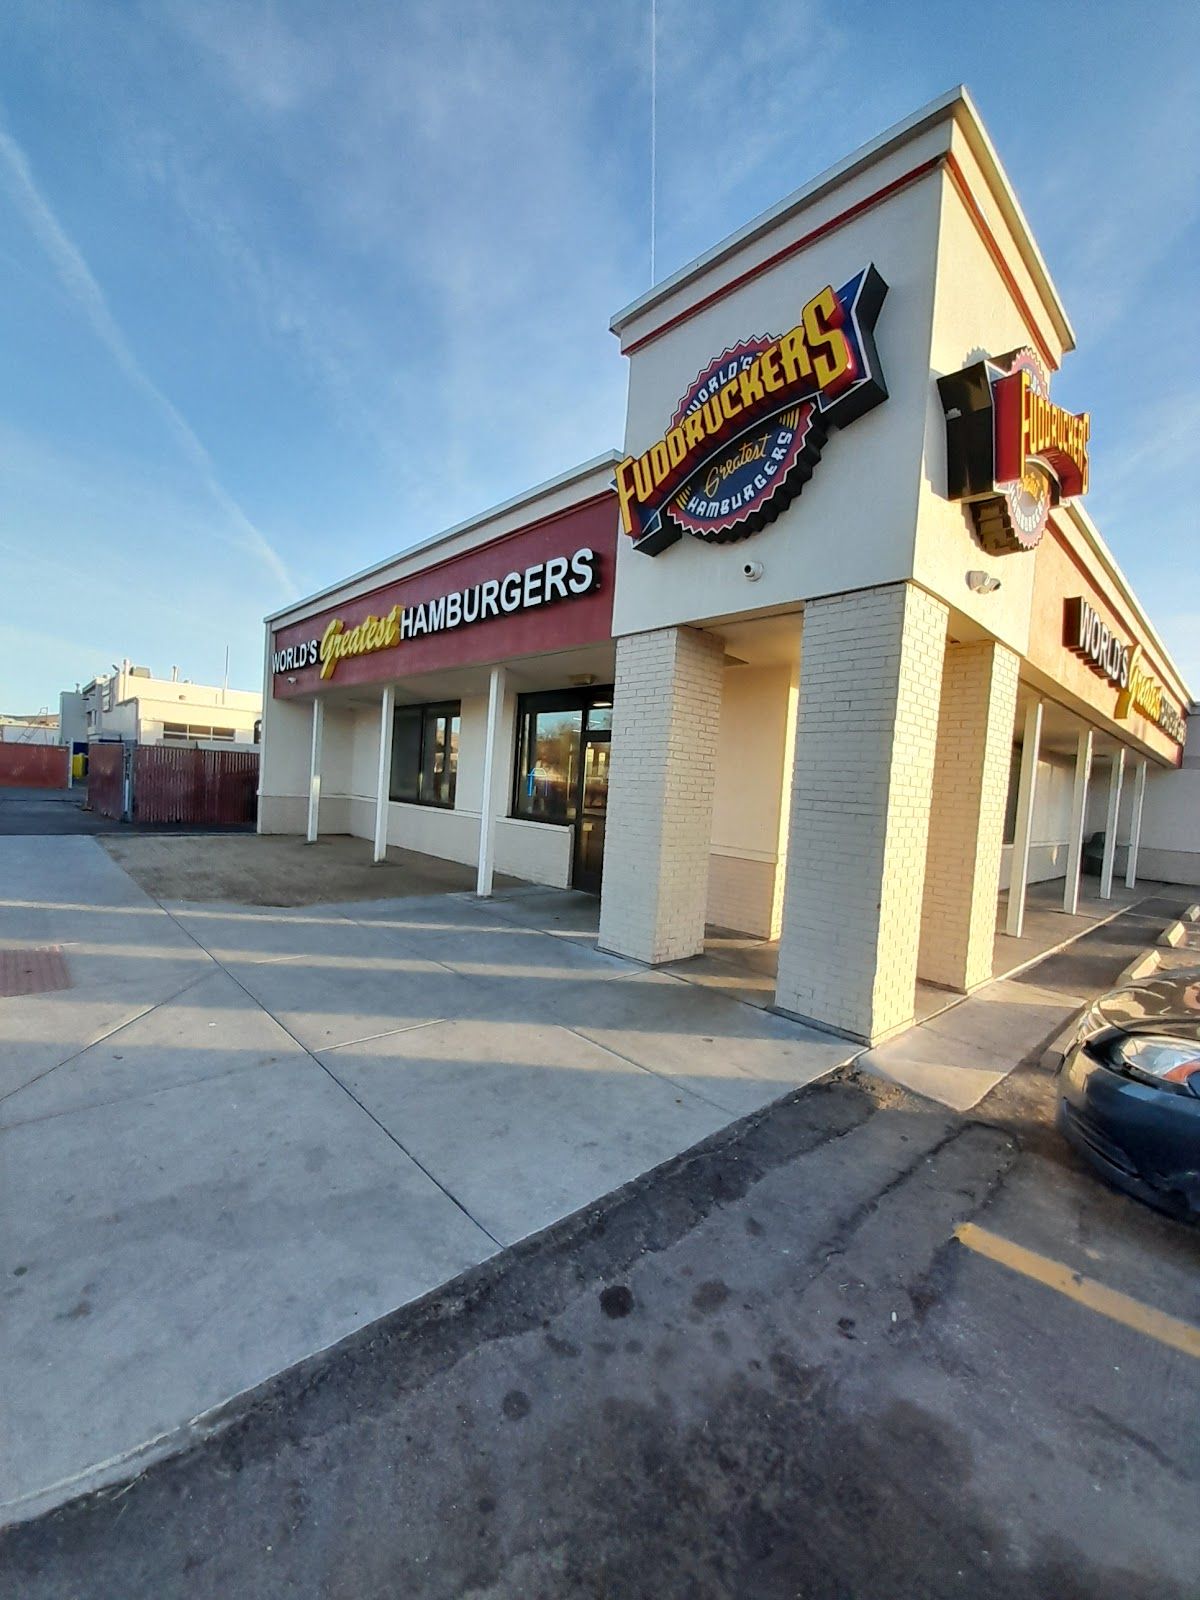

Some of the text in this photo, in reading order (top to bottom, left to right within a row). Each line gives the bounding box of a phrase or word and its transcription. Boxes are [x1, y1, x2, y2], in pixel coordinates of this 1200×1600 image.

[614, 284, 850, 536] FUDDRUCKERS
[687, 430, 793, 518] HAMBURGERS
[703, 432, 772, 498] Greatest
[271, 547, 594, 680] WORLD'S Greatest HAMBURGERS
[1079, 597, 1129, 689] WORLD'S
